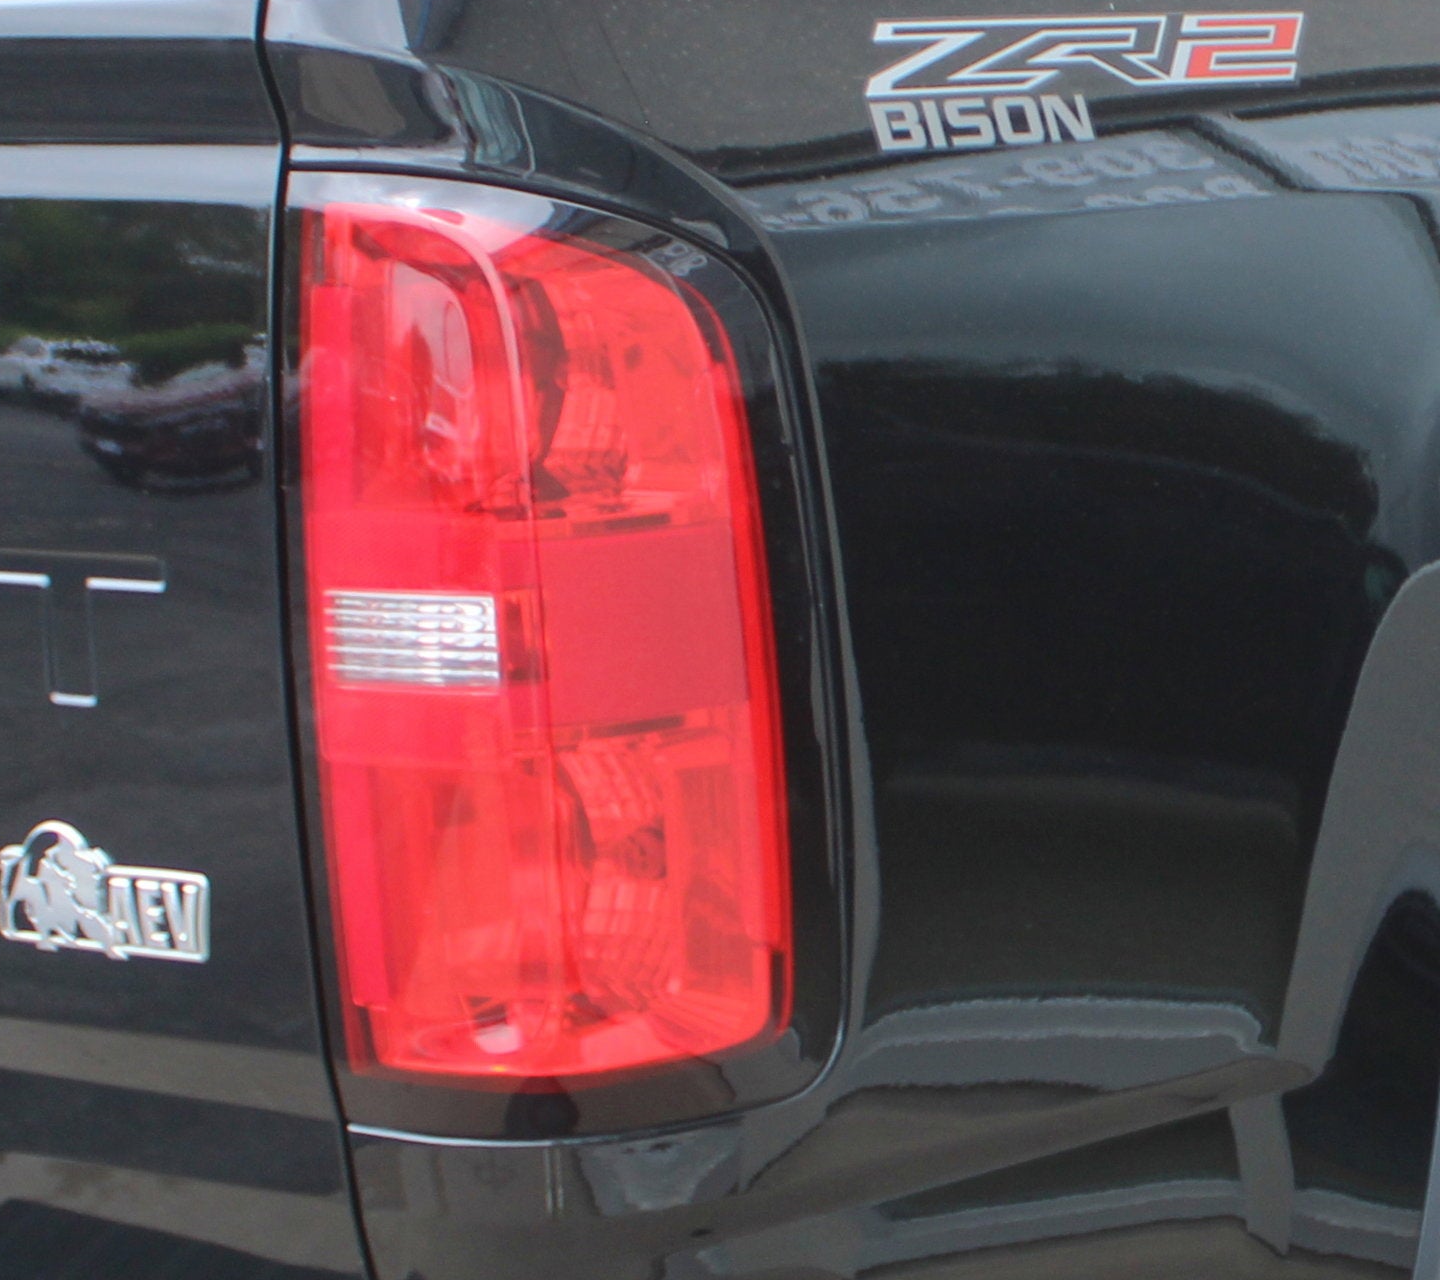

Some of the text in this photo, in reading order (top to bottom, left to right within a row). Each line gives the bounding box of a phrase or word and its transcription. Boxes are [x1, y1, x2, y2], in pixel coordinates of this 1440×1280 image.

[865, 12, 1304, 98] ZR2
[868, 93, 1096, 153] BISON
[108, 876, 200, 953] AEV
